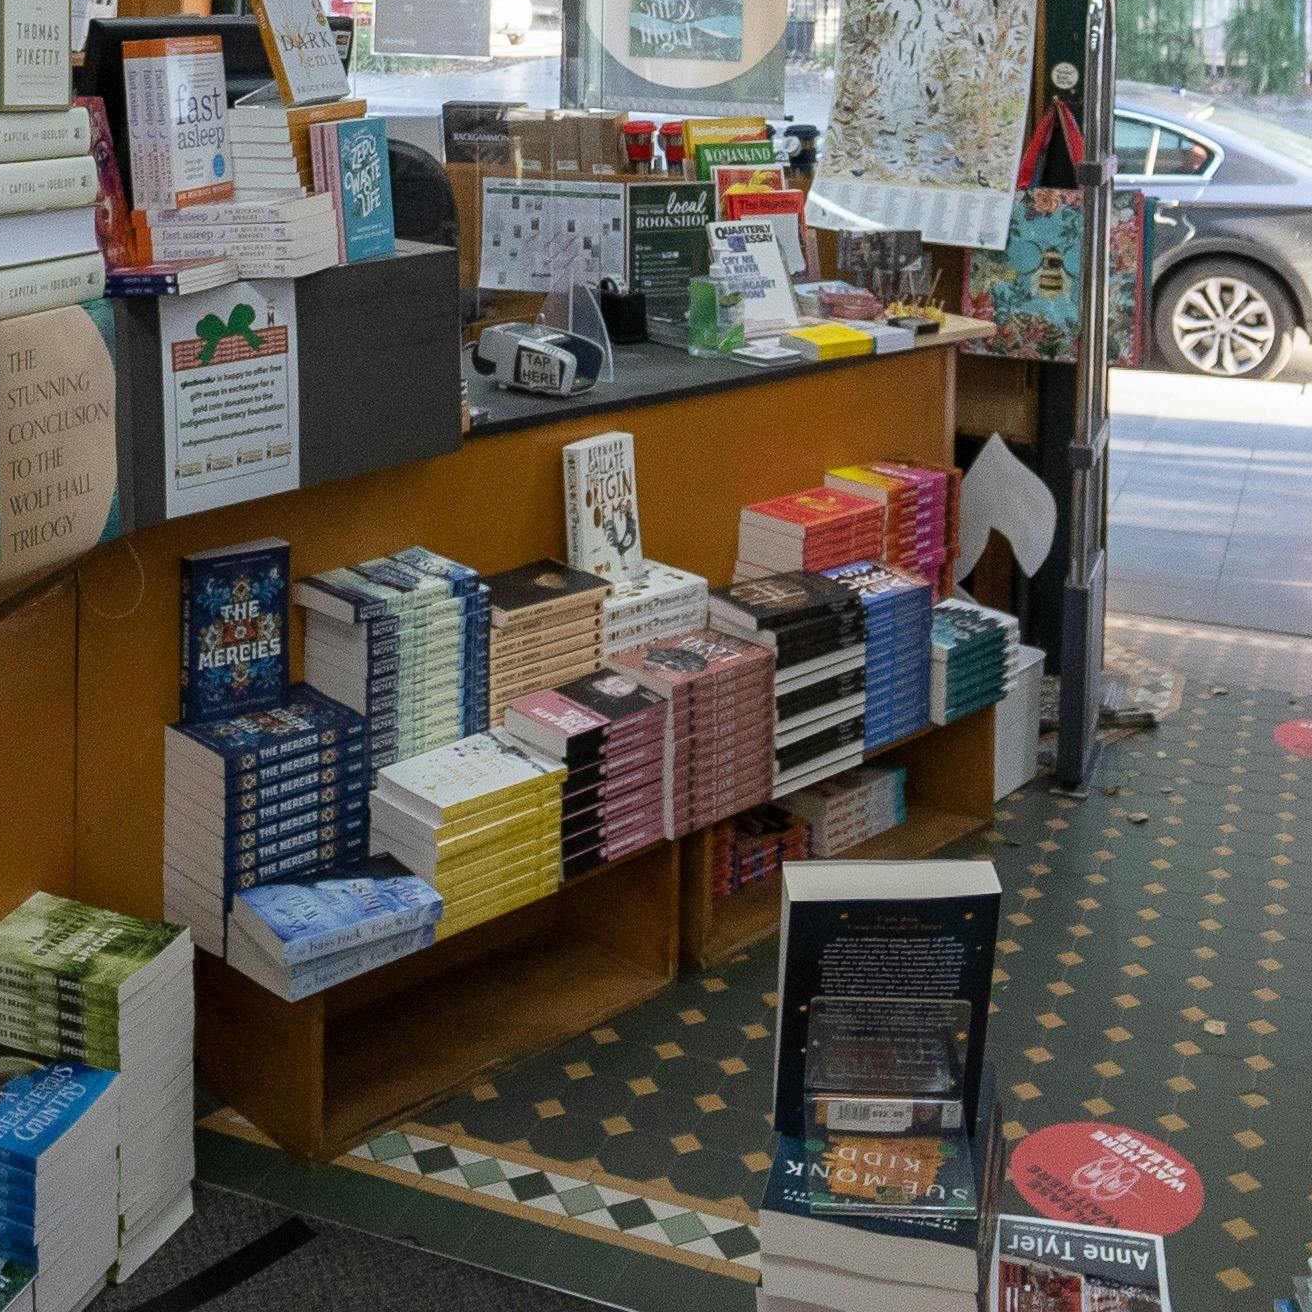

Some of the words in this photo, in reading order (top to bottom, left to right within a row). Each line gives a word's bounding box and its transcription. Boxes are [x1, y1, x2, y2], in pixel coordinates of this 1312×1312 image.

[16, 21, 60, 42] THOMAS
[282, 34, 333, 53] DARK
[16, 46, 60, 67] PIKETTY
[175, 84, 223, 125] fast
[177, 125, 226, 152] asleep
[452, 131, 511, 142] BACKGAMMON
[349, 135, 378, 170] ZERO
[703, 146, 772, 163] WOMANKIND
[349, 158, 382, 196] WASTE
[358, 193, 382, 220] LIFE
[666, 190, 708, 216] local
[738, 200, 759, 210] The
[759, 198, 801, 211] Monthly
[636, 214, 709, 230] BOOKSHOP
[714, 224, 771, 240] QUARTERLY
[745, 234, 774, 244] ESSAY
[7, 348, 38, 374] THE
[526, 353, 551, 367] TAP
[223, 370, 244, 382] happy
[244, 368, 253, 378] to
[521, 369, 557, 386] HERE
[7, 371, 92, 411] STUNNING
[192, 405, 208, 416] gold
[224, 396, 254, 409] donation
[254, 394, 262, 403] to
[262, 392, 274, 401] the
[247, 402, 286, 416] foundation
[8, 399, 110, 446] CONCLUSION
[9, 458, 32, 481] TO
[34, 447, 64, 471] THE
[9, 485, 55, 516] WOLF
[55, 473, 94, 503] HALL
[586, 468, 633, 509] ORIGIN
[10, 513, 77, 554] TRILOGY
[220, 599, 261, 623] THE
[0, 1089, 20, 1103] A
[13, 1081, 87, 1142] COUNTRY
[837, 1145, 922, 1173] KIDD
[1090, 1129, 1142, 1163] HERE
[1115, 1132, 1186, 1177] PLEASE
[784, 1159, 888, 1186] MONK
[1140, 1160, 1187, 1194] WAIT
[901, 1179, 969, 1201] SUE
[1007, 1232, 1075, 1262] Tyler
[1082, 1244, 1151, 1271] Anne
